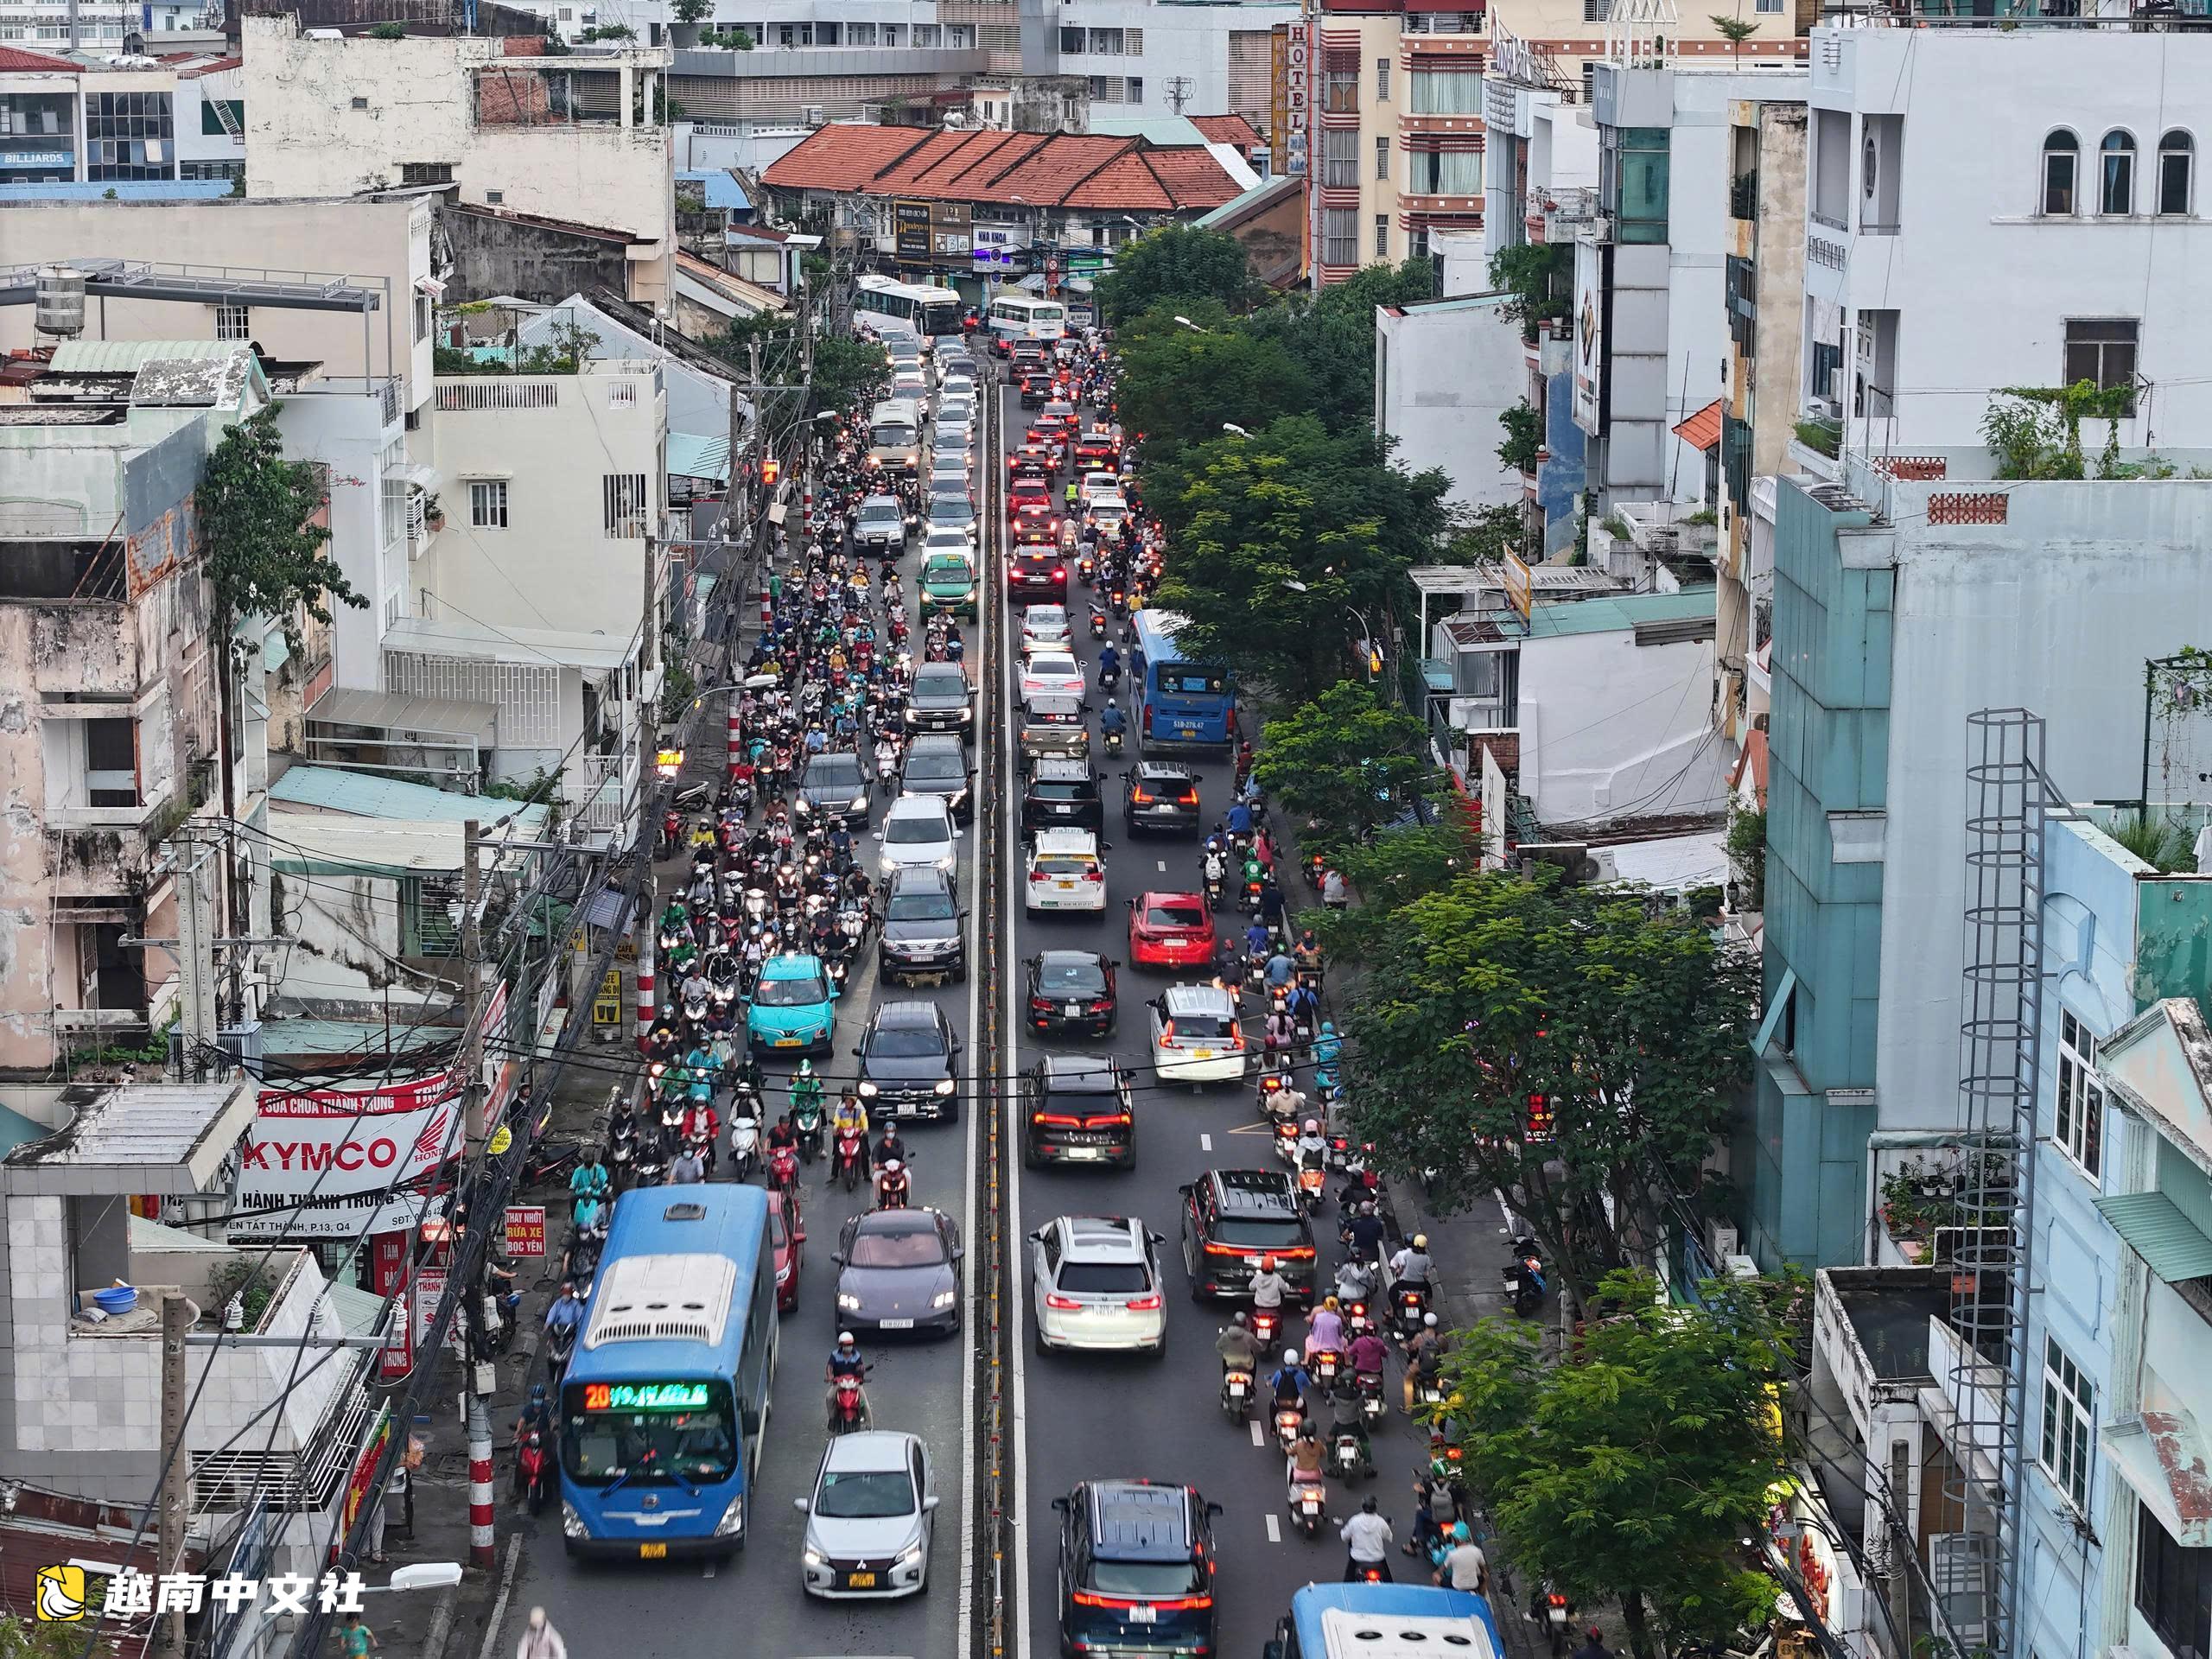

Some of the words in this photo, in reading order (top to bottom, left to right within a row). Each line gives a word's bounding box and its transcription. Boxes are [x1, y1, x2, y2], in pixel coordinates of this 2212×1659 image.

[1291, 27, 1305, 129] HOTEL
[4, 154, 65, 163] BILLIARDS
[243, 1137, 397, 1171] KYMCO
[415, 1147, 446, 1162] HOND
[243, 1190, 284, 1208] HÀNH
[392, 1215, 413, 1225] SĐT:
[505, 1211, 523, 1223] THAY
[524, 1211, 542, 1223] NHỚT
[507, 1224, 527, 1237] RỬA
[530, 1227, 543, 1237] XE
[507, 1241, 524, 1255] BỌC
